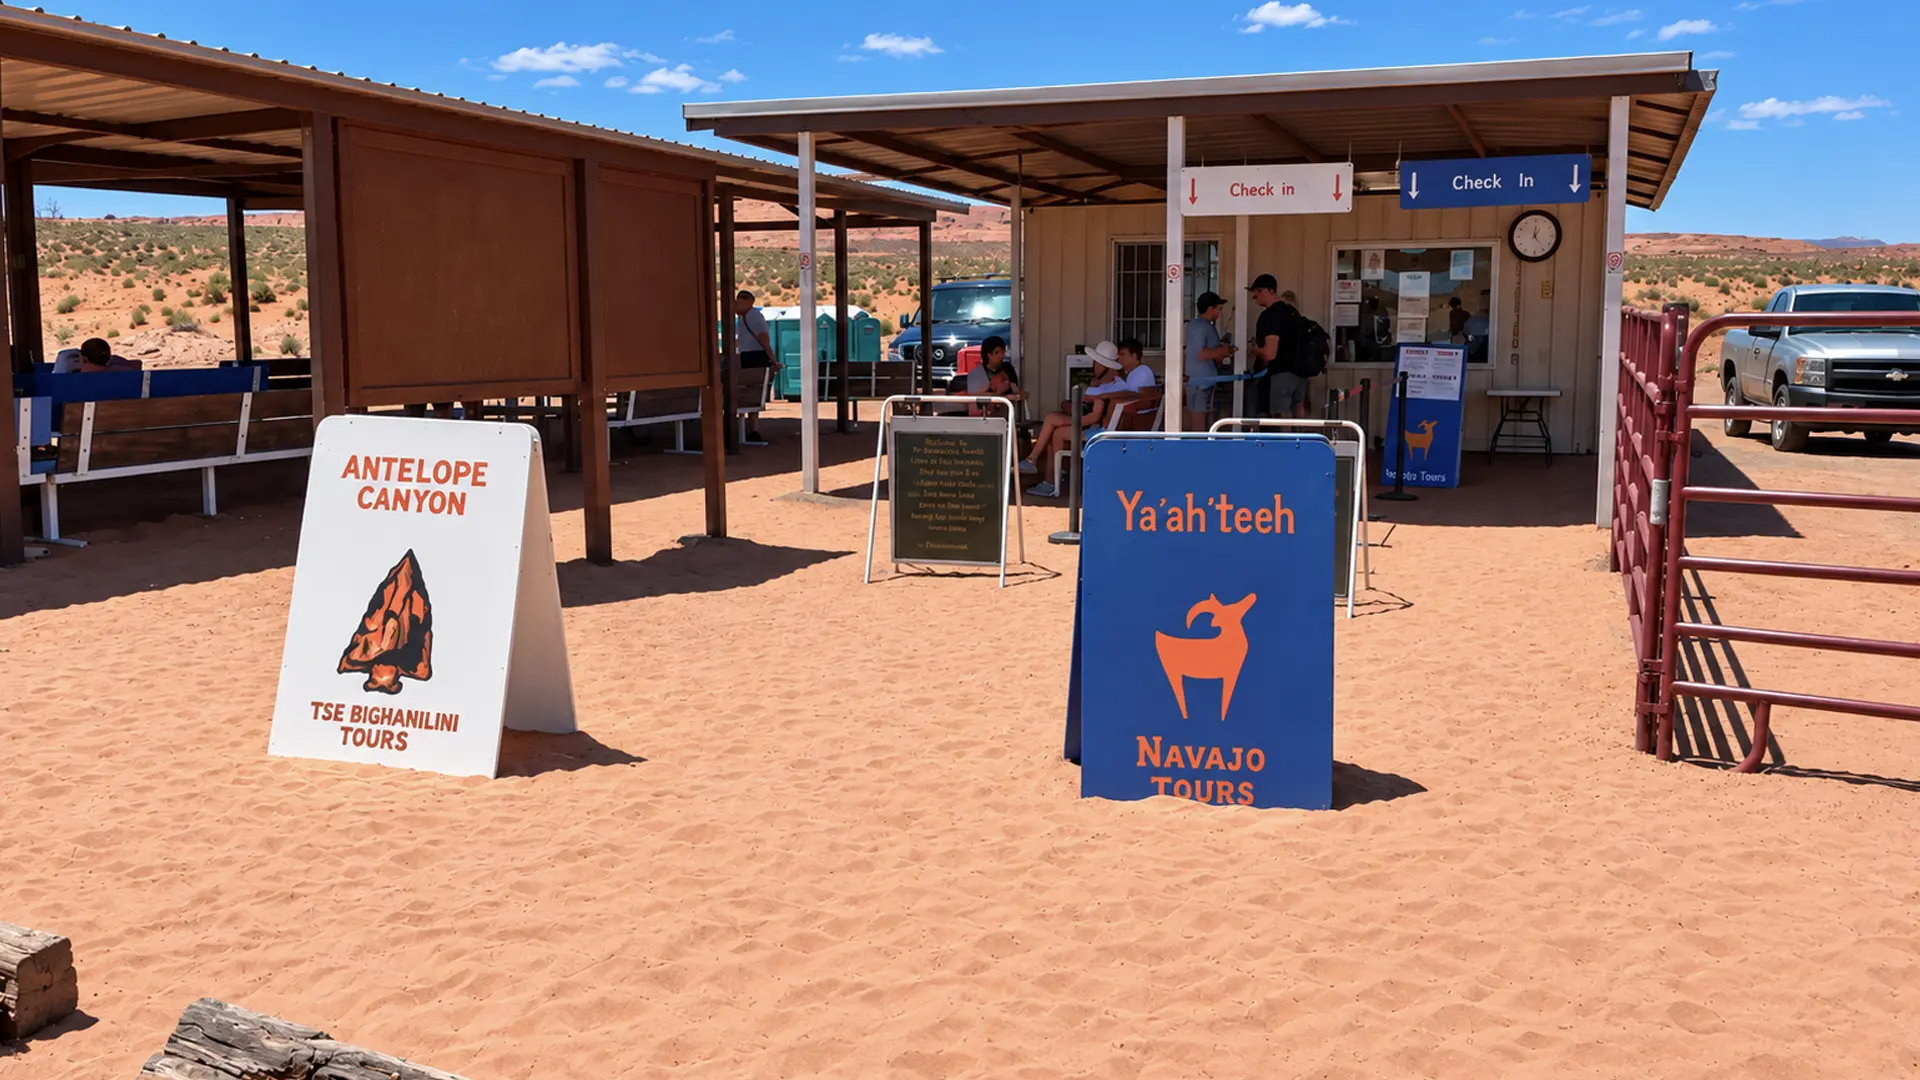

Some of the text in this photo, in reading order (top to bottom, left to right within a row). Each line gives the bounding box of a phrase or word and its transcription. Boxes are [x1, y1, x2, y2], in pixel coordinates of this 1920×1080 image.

[1229, 181, 1295, 197] Check in
[1452, 173, 1534, 190] Check In
[341, 455, 489, 487] ANTELOPE
[1419, 471, 1446, 482] Tours
[357, 486, 467, 516] CANYON
[1116, 490, 1295, 534] Ya'ah'teeh
[311, 701, 460, 733] TSE BIGHANILINI
[340, 726, 409, 752] TOURS
[1136, 735, 1265, 773] NAVAJO
[1150, 776, 1255, 805] TOURS
